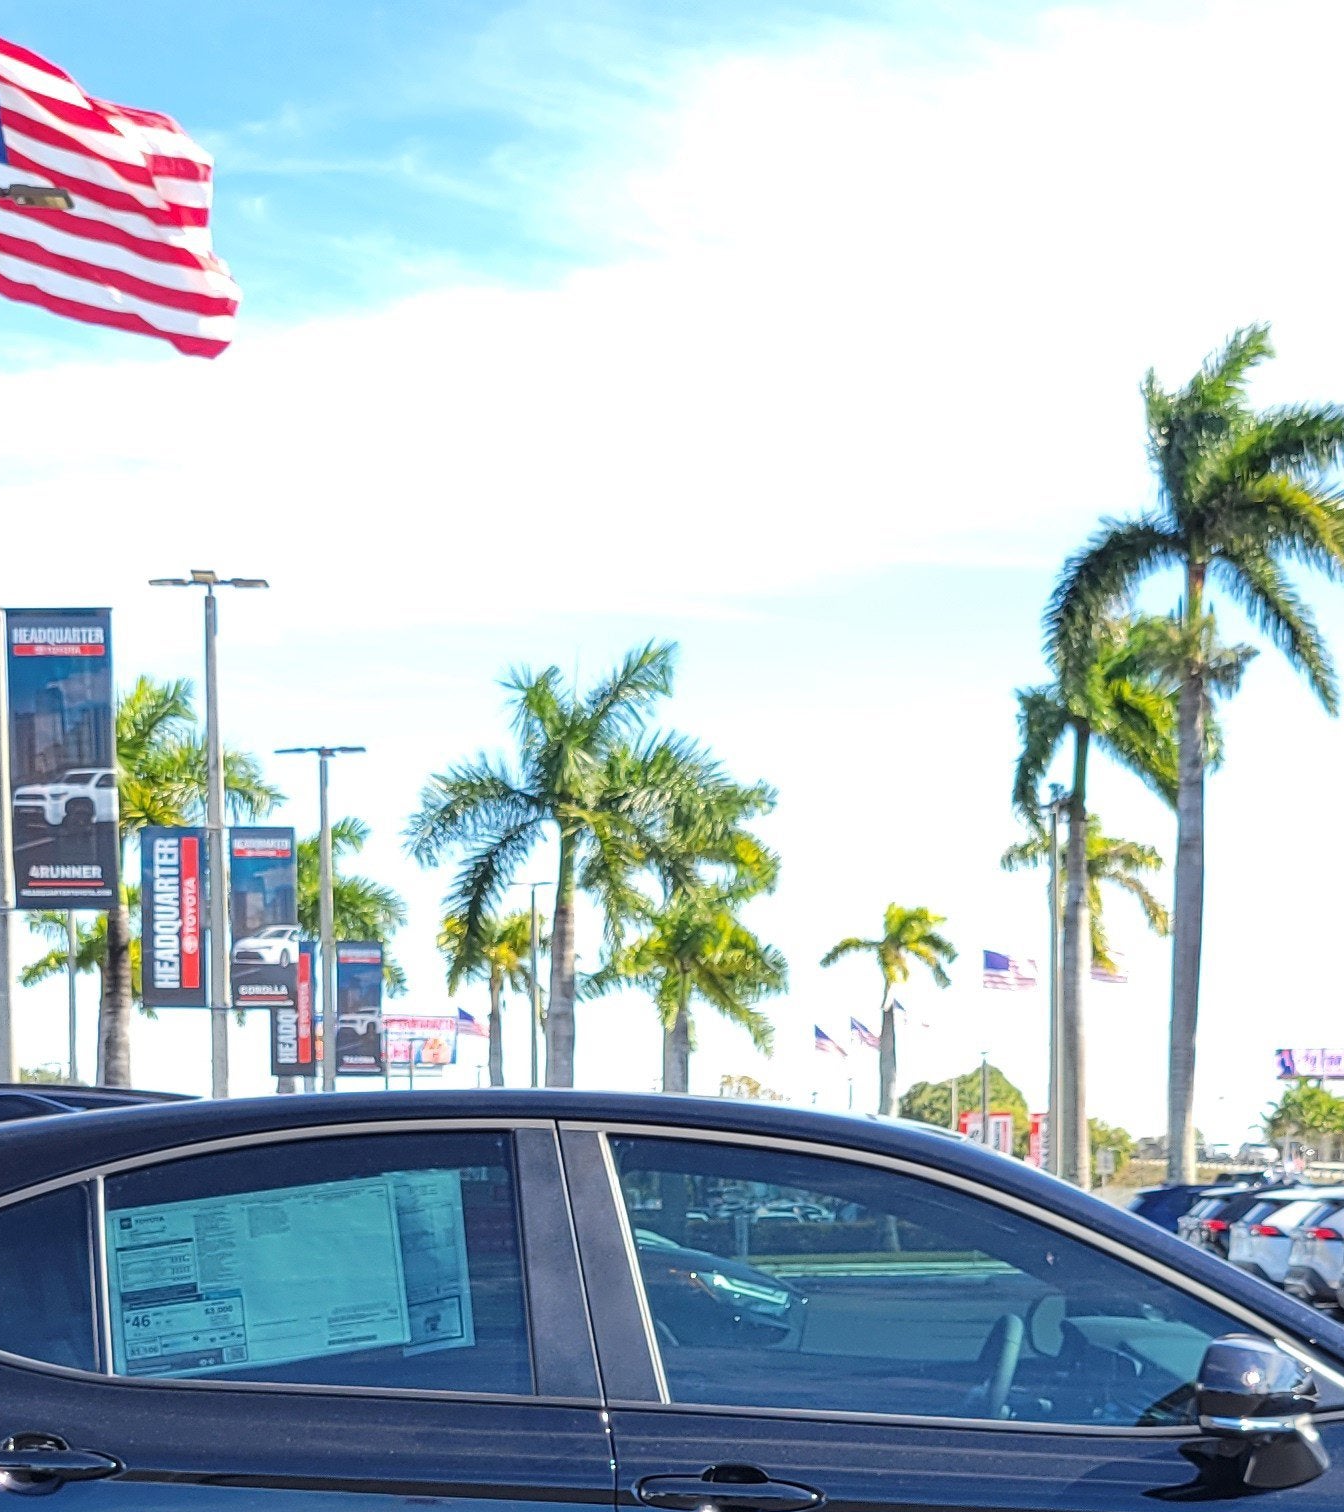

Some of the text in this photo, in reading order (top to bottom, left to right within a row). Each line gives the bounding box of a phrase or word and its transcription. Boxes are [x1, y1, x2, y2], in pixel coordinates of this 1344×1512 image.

[12, 627, 105, 645] HEADQUARTER
[28, 865, 103, 879] 4RUNNER
[153, 837, 183, 989] HEADQUARTER
[183, 877, 197, 933] TOYOTA
[131, 1314, 151, 1329] 46
